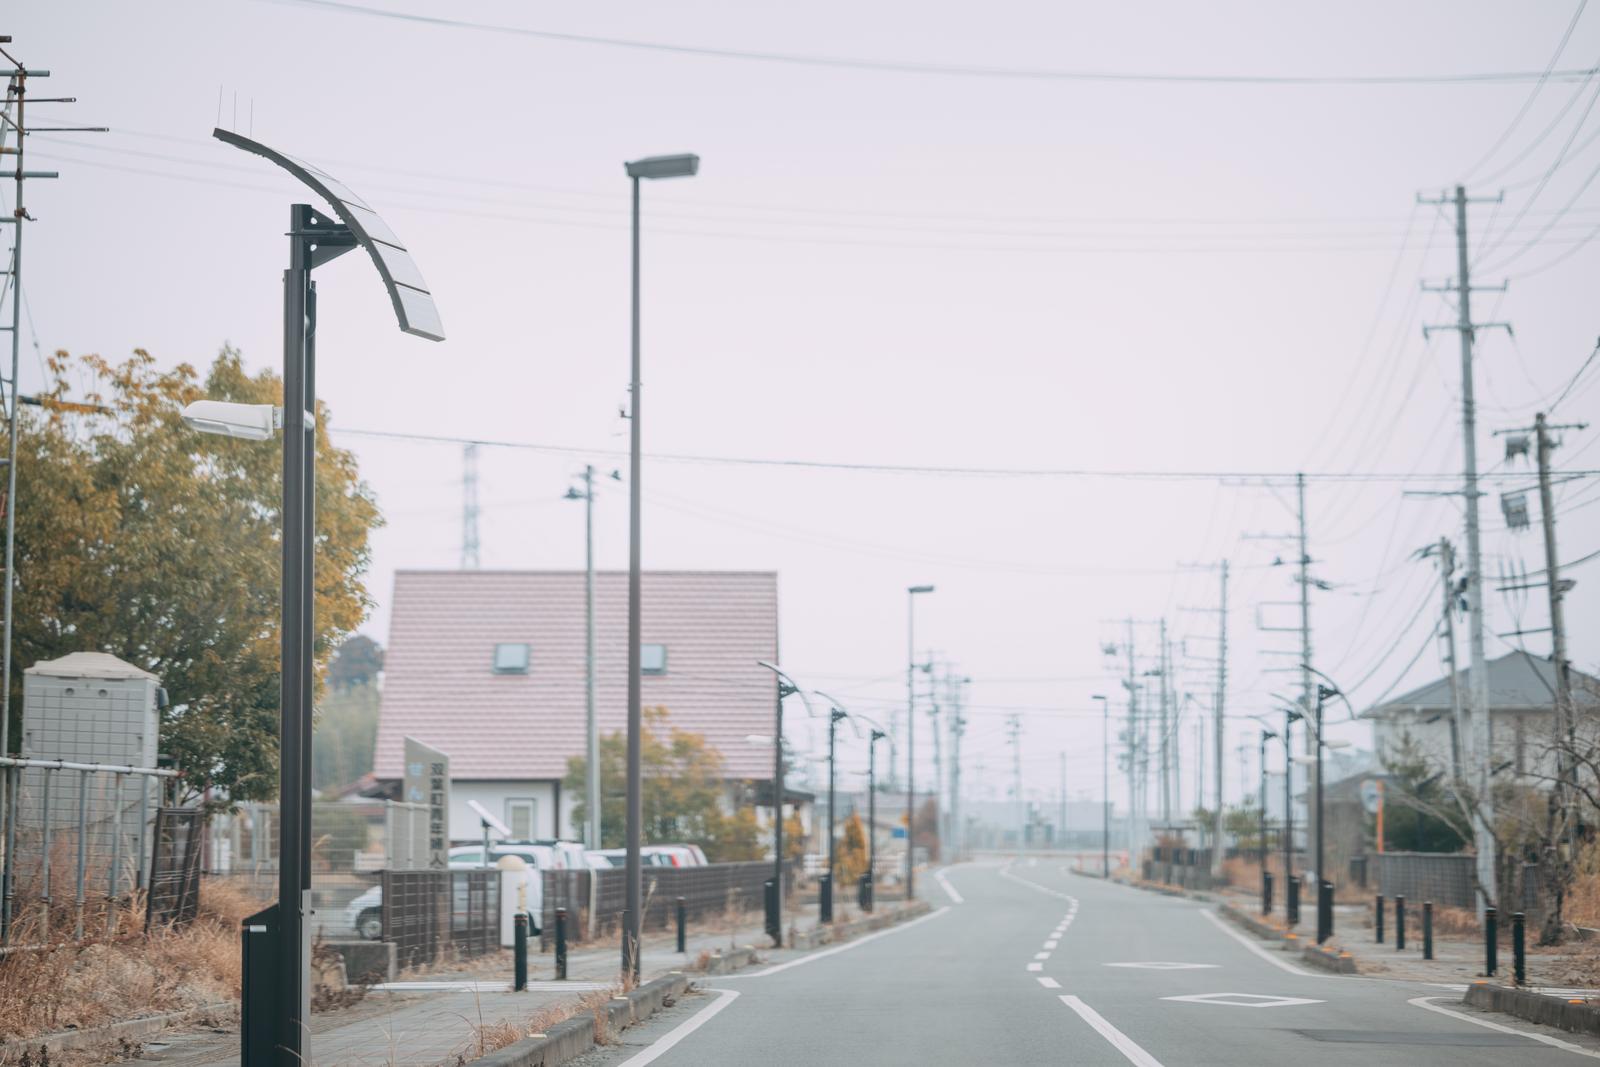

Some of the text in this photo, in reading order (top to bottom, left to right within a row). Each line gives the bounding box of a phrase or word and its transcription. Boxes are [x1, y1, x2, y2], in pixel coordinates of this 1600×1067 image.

[430, 762, 445, 869] 双葉町青年婦人
